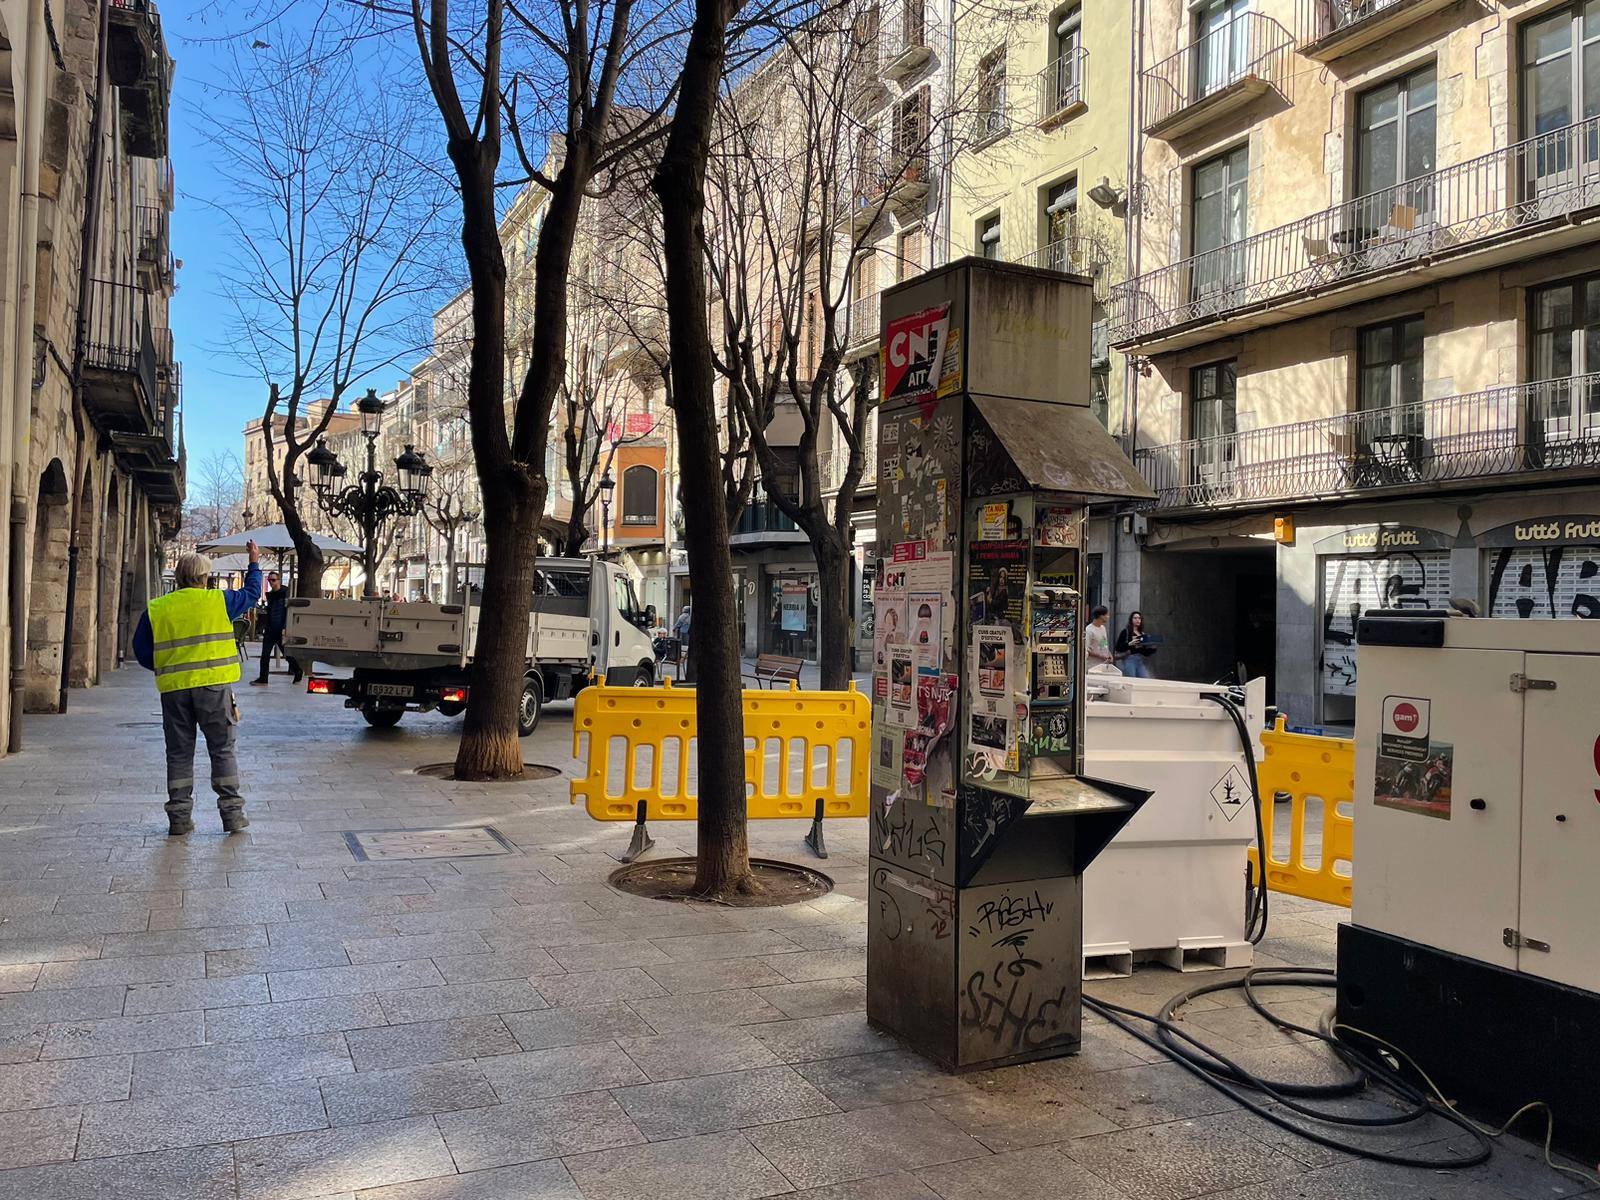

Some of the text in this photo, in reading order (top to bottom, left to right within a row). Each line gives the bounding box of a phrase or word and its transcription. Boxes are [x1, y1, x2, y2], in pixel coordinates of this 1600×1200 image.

[889, 318, 949, 368] CNT
[1381, 530, 1420, 546] frutti
[886, 571, 906, 588] CNT
[1394, 713, 1413, 722] gam
